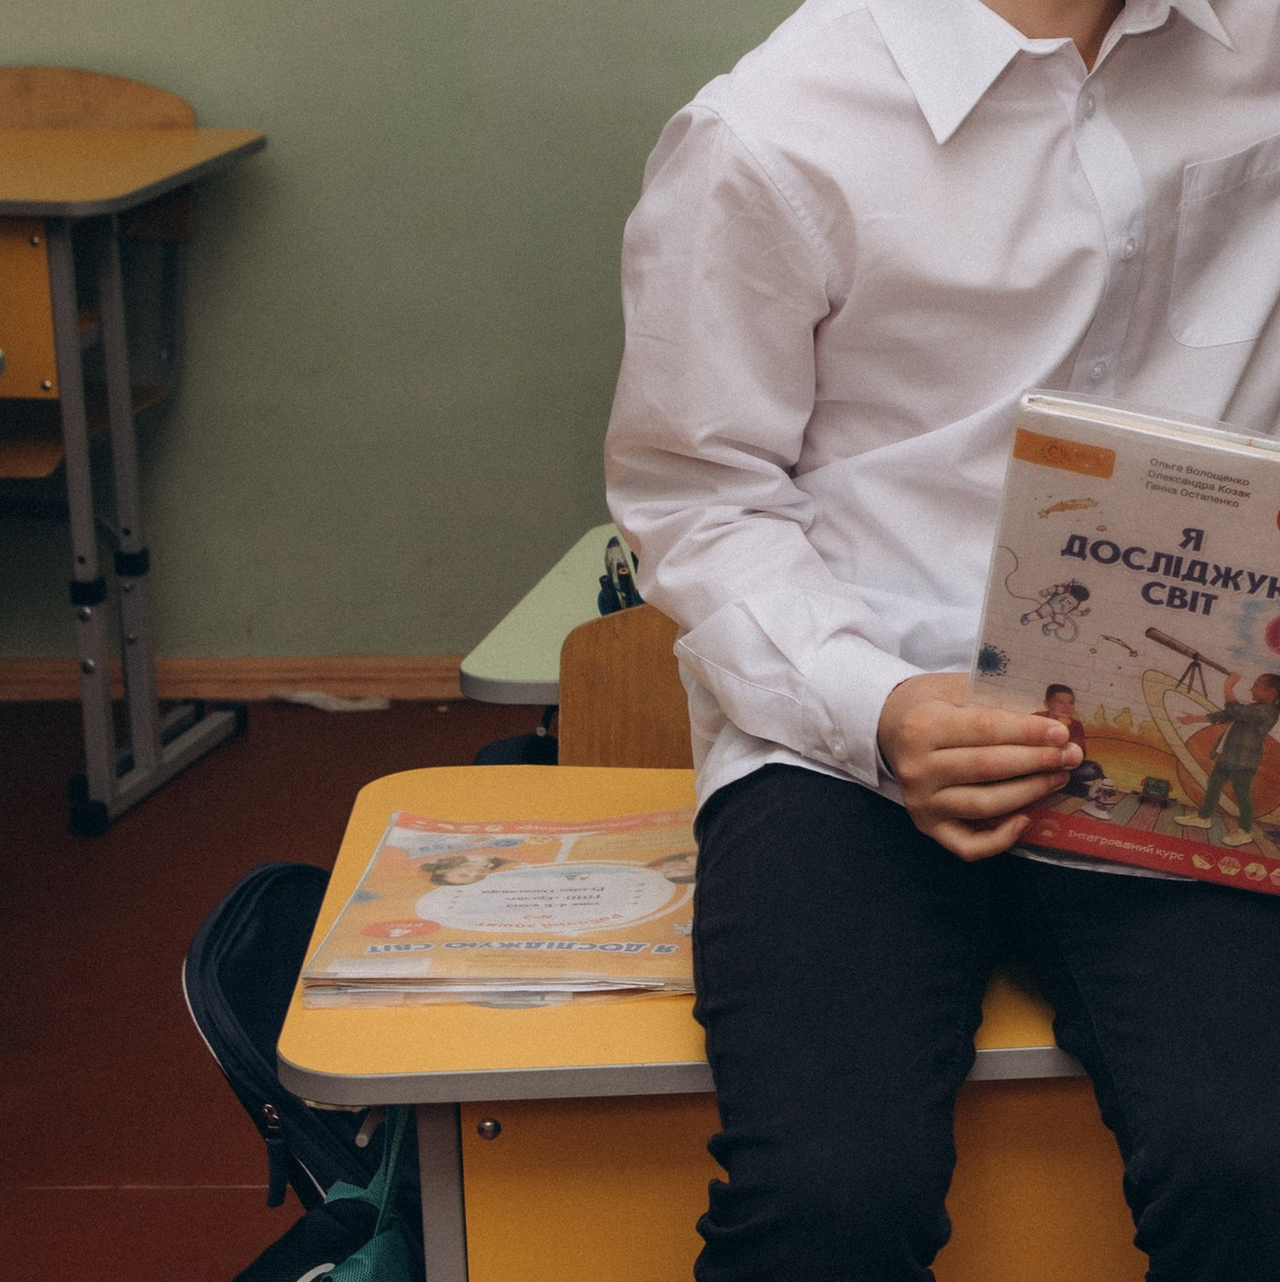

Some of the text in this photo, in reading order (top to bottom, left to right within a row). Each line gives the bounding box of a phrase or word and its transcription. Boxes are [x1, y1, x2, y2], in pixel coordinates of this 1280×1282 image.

[1147, 470, 1252, 500] Олександра Козак
[1149, 458, 1250, 487] Ольга Волощенко
[1145, 480, 1240, 509] Ганна Остапенко
[1178, 527, 1205, 552] Я
[1140, 581, 1220, 616] СВІТ
[1066, 828, 1185, 862] Інтегрований курс
[367, 942, 677, 955] Я ДОСЛІДЖУЮ СВІТ
